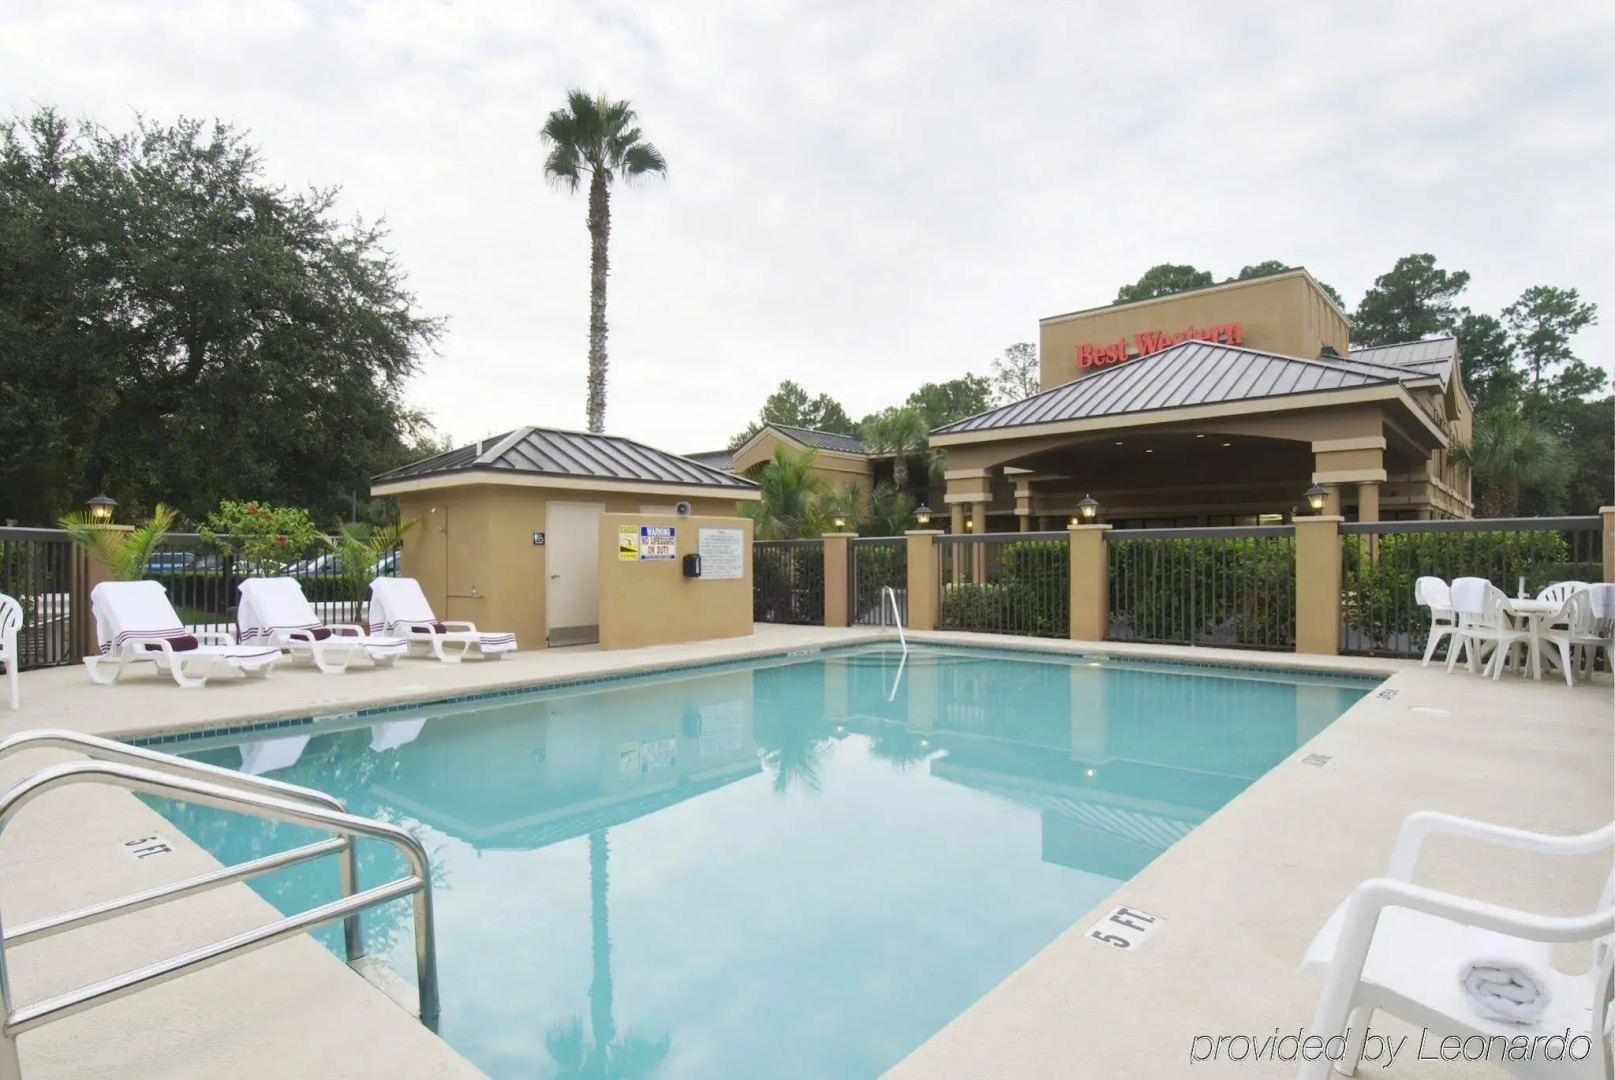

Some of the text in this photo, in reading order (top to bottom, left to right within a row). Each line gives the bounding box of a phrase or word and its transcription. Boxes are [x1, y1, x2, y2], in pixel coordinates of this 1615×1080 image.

[1076, 337, 1129, 369] Best
[641, 536, 675, 545] NO LIFEGUARD
[648, 545, 669, 554] ON DUTY
[124, 836, 158, 846] 5
[1091, 930, 1130, 948] 5
